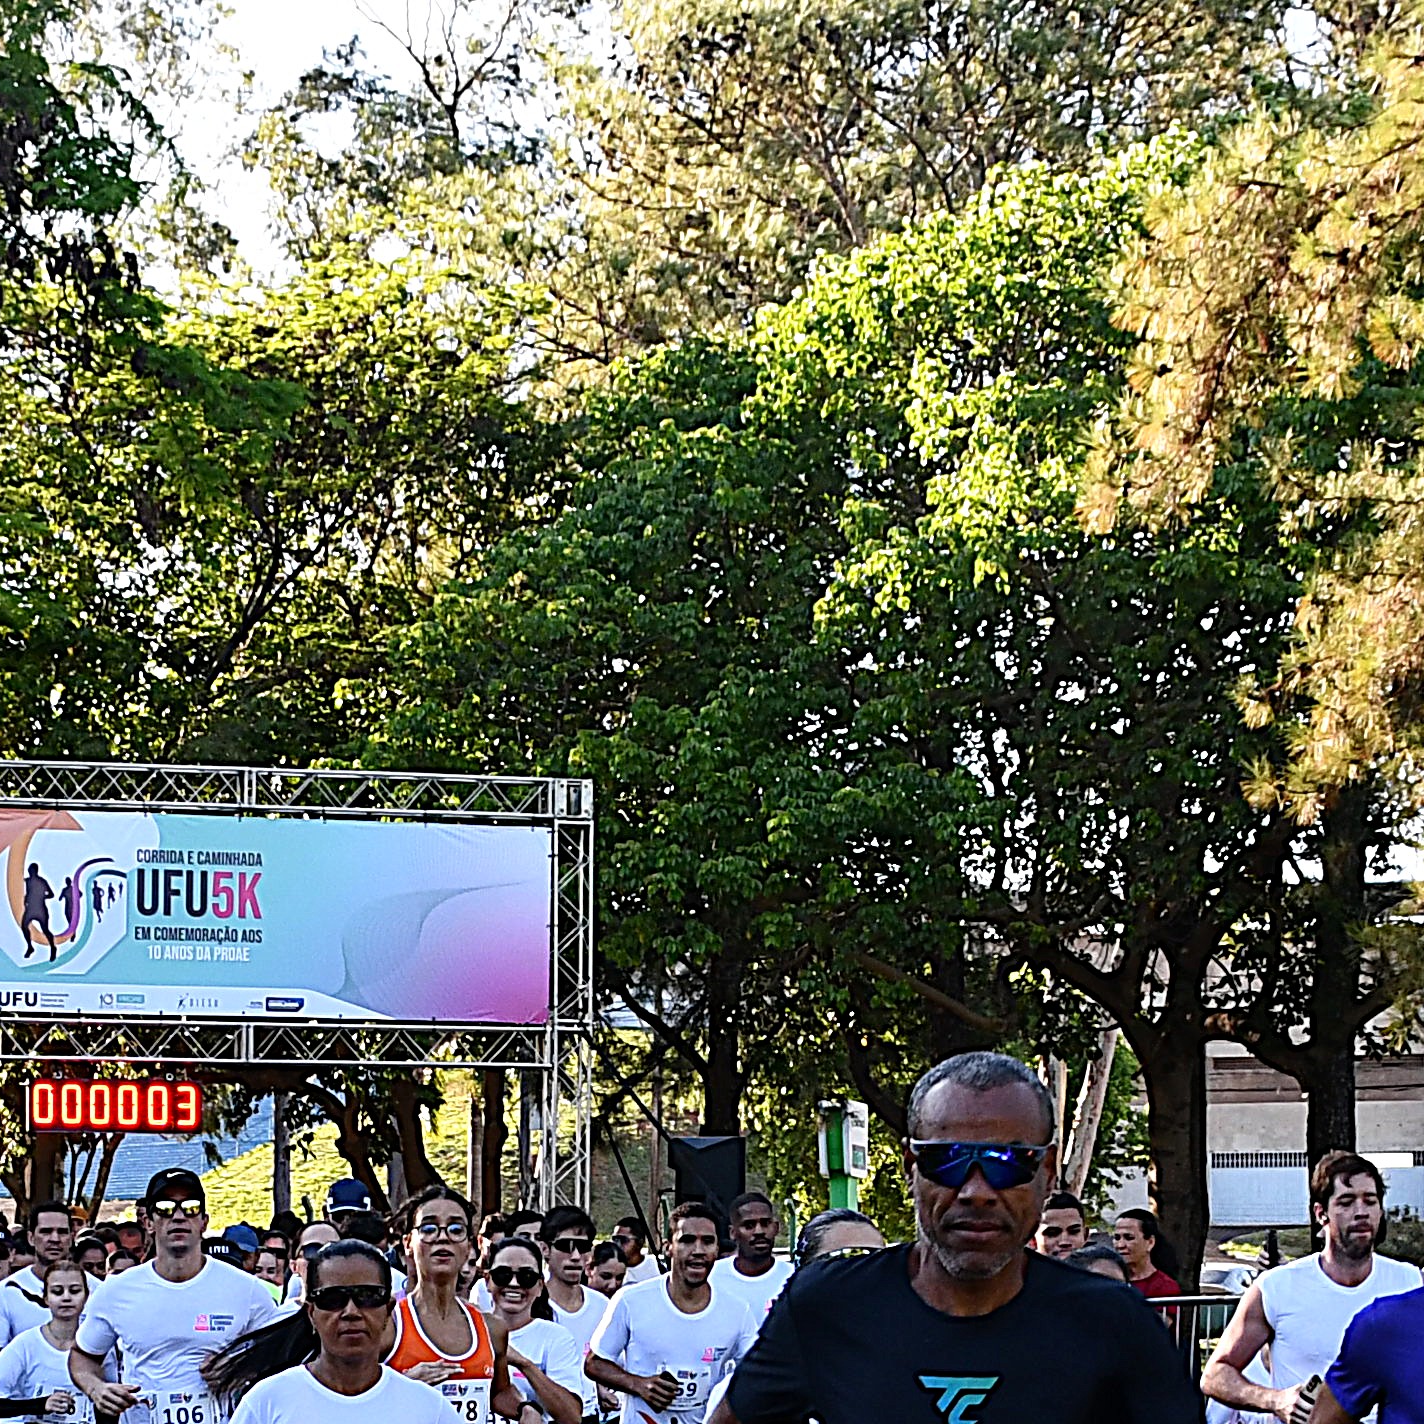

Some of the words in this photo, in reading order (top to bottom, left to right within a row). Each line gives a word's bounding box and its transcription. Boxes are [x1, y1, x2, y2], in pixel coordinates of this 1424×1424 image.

[136, 848, 185, 865] CORRIDA
[187, 850, 194, 866] E
[197, 850, 263, 867] CAMINHADA
[136, 868, 263, 920] UFU5K
[134, 926, 151, 941] EM
[153, 925, 238, 945] COMEMORAÇÃO
[240, 929, 263, 944] AOS
[147, 945, 162, 960] 10
[164, 945, 194, 961] ANOS
[196, 946, 212, 961] DA
[213, 946, 250, 962] PROAE
[32, 1083, 196, 1126] 000003
